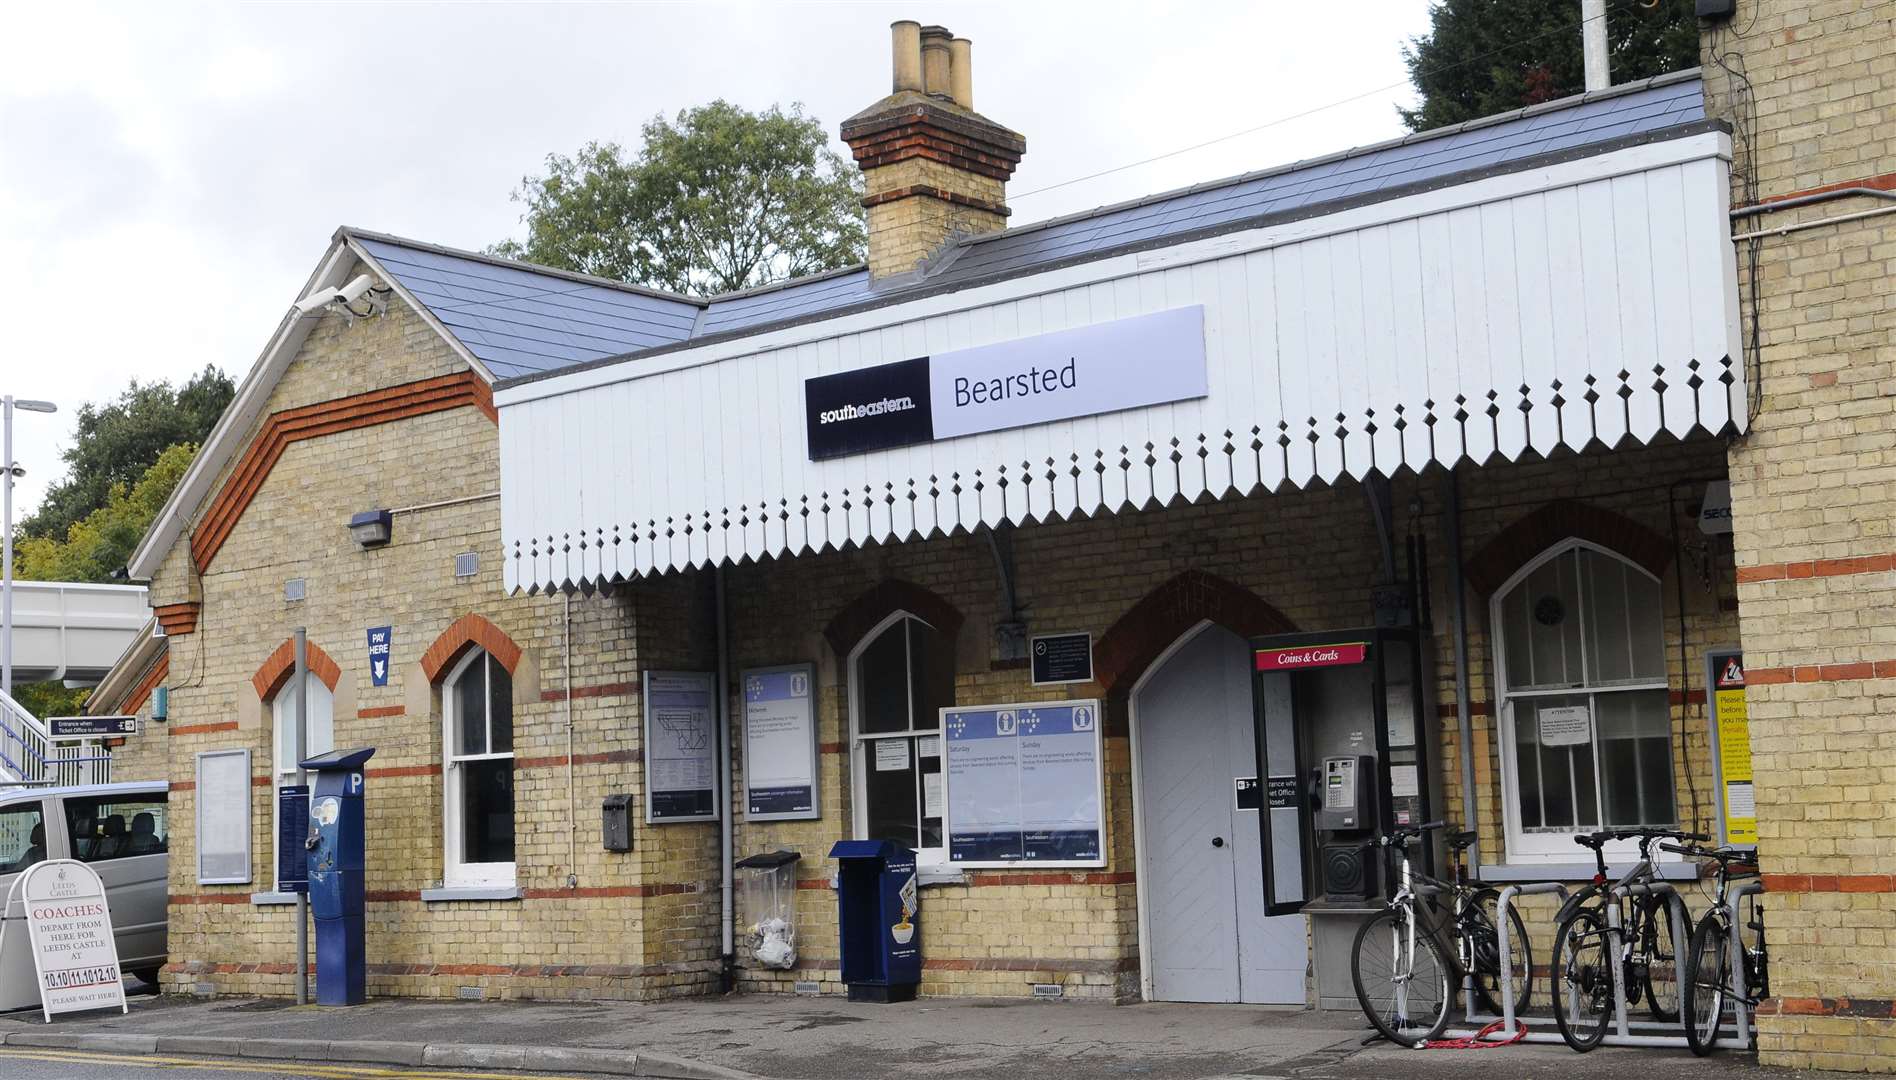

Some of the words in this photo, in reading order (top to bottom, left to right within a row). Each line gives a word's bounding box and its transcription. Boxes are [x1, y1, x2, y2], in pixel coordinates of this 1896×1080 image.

[954, 357, 1077, 408] Bearsted
[372, 632, 385, 643] PAY
[369, 644, 389, 655] HERE
[1277, 652, 1302, 664] Coins
[1303, 653, 1311, 662] &
[1312, 650, 1339, 662] Cards
[1720, 695, 1741, 704] Please
[351, 773, 362, 794] P
[33, 903, 103, 920] COACHES
[40, 922, 74, 932] DEPART
[76, 920, 102, 929] FROM
[51, 932, 75, 942] HERE
[77, 931, 96, 940] FOR
[43, 943, 71, 952] LEEDS
[73, 940, 106, 950] CASTLE
[71, 952, 82, 960] AT
[45, 972, 68, 988] 10.10
[71, 970, 93, 985] 11.10
[94, 967, 117, 982] 12.10
[52, 996, 78, 1005] PLEASE
[79, 994, 96, 1002] WAIT
[97, 992, 117, 1000] HERE
